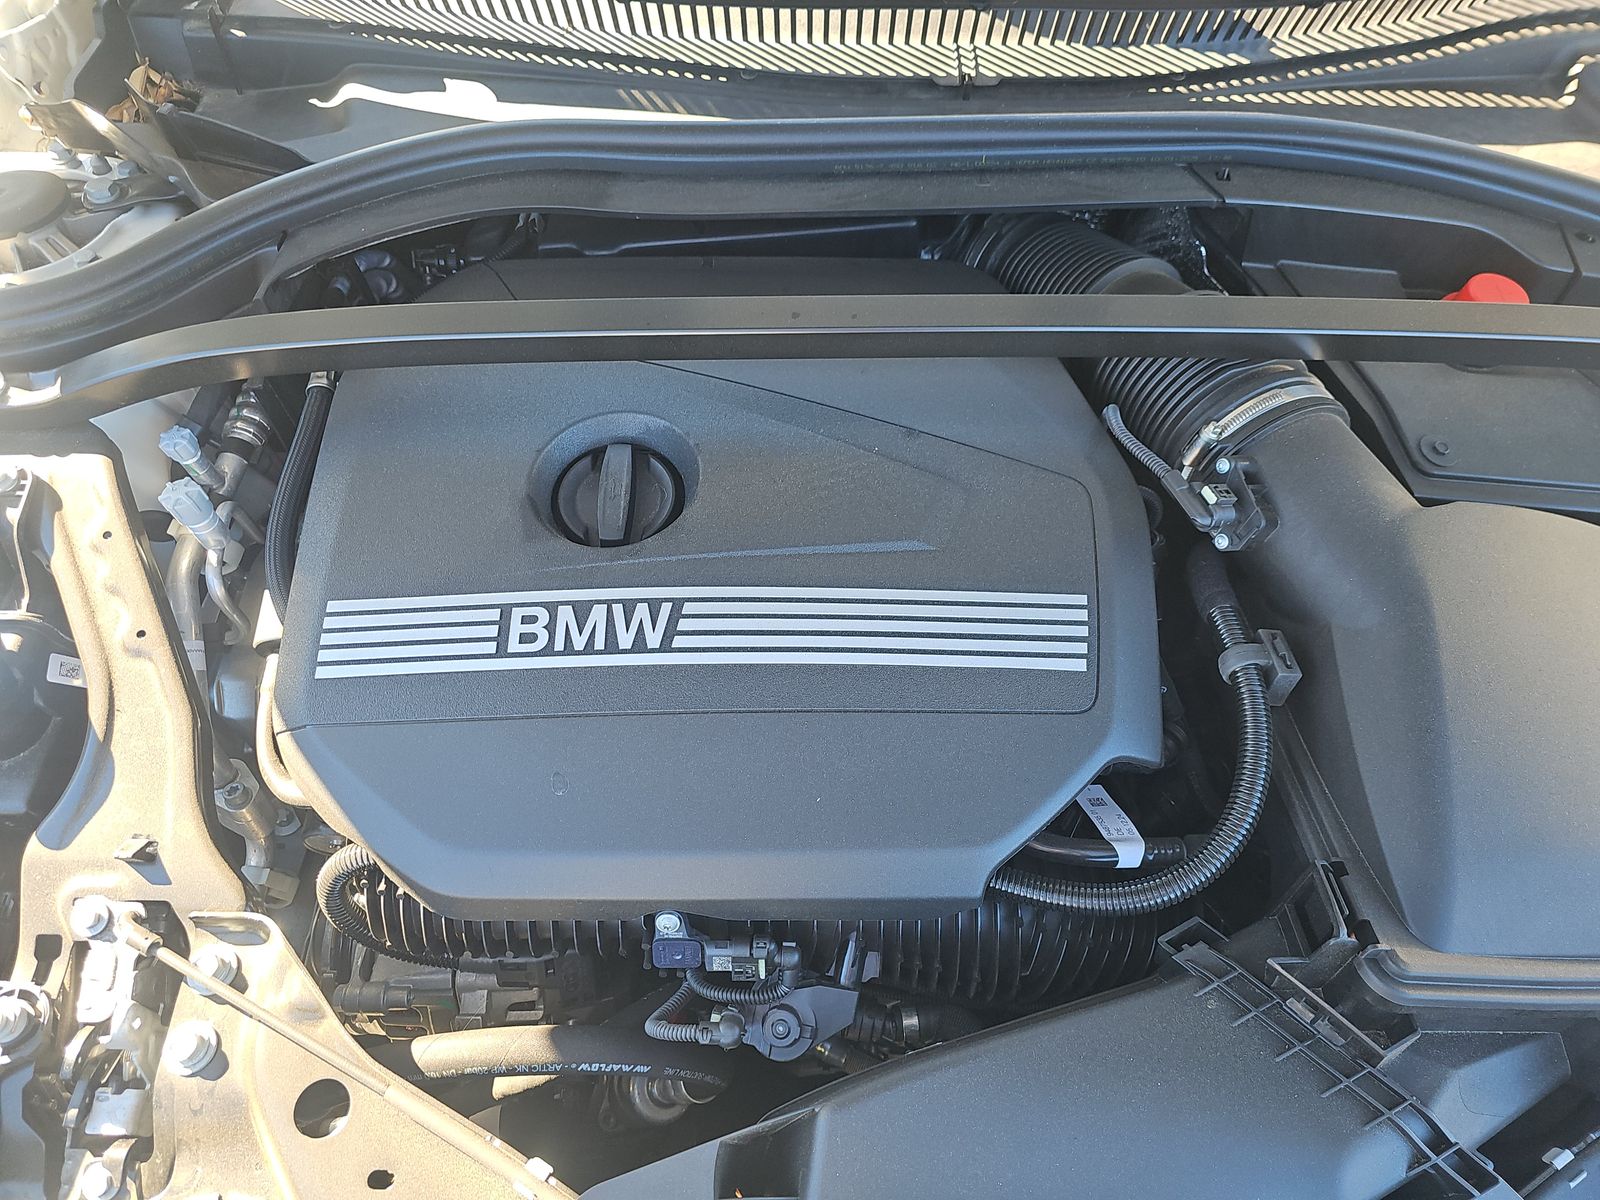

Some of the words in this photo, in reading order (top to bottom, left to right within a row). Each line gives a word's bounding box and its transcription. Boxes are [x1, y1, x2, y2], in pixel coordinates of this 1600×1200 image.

[507, 602, 673, 653] BMW
[1113, 827, 1124, 836] DE
[464, 1066, 488, 1075] 20bar
[515, 1063, 528, 1073] NK
[531, 1063, 562, 1072] ARTIC
[577, 1062, 634, 1073] MAFLOW
[663, 1067, 680, 1076] LINE
[443, 1069, 457, 1078] DN
[678, 1069, 705, 1079] SUCTION
